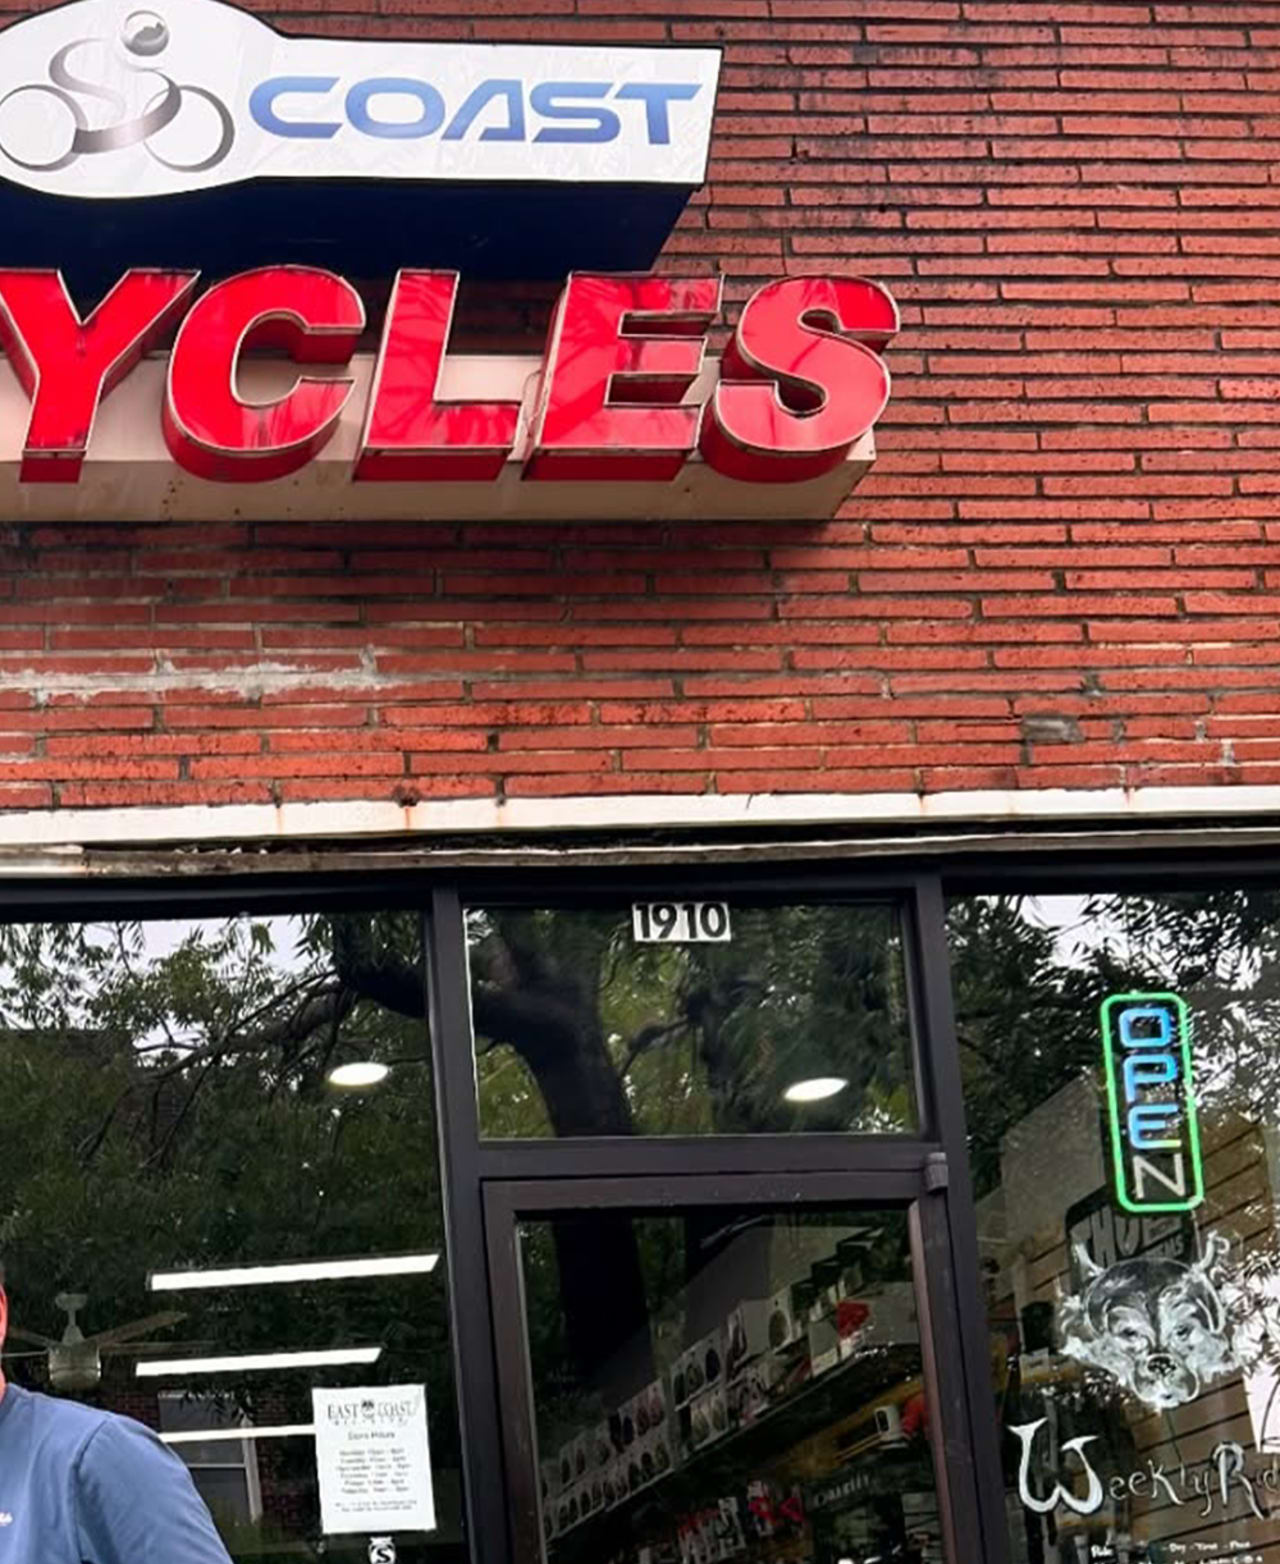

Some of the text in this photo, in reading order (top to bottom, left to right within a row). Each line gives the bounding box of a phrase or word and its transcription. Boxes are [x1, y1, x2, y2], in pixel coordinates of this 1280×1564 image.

[252, 76, 701, 146] COAST
[635, 905, 729, 942] 1910
[1118, 1005, 1186, 1200] OPEN
[327, 1403, 359, 1420] EAST
[1008, 1417, 1212, 1516] Weekly
